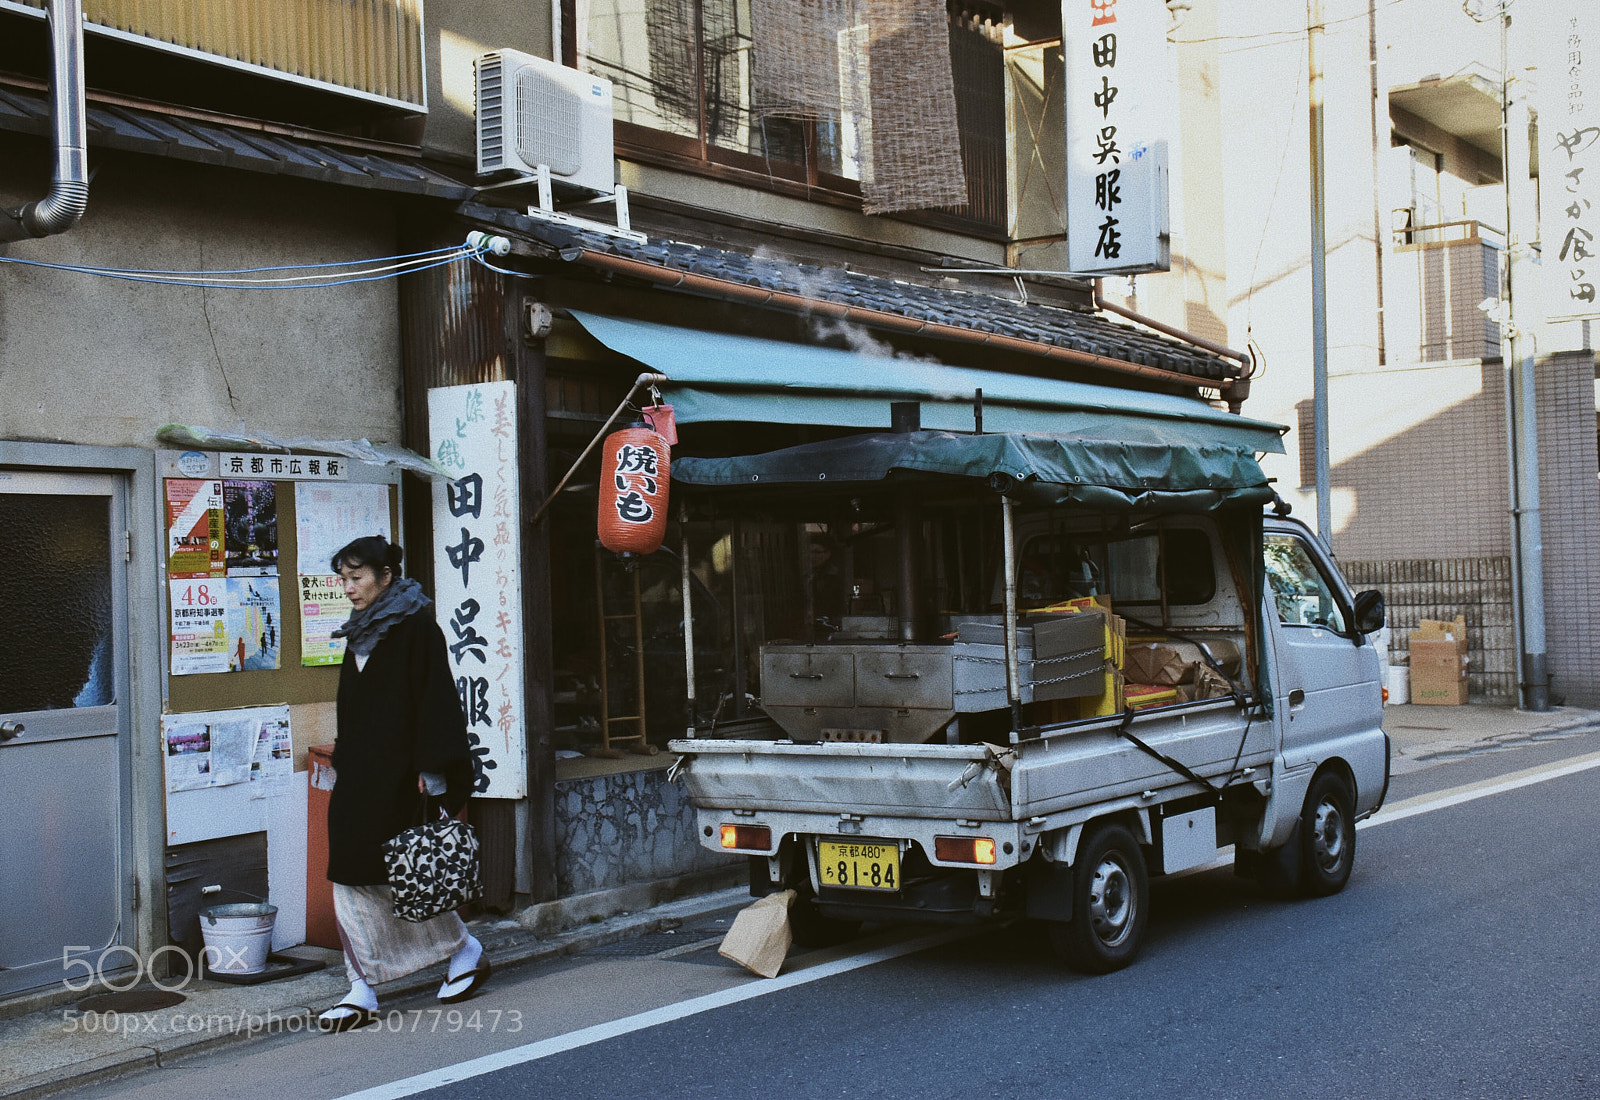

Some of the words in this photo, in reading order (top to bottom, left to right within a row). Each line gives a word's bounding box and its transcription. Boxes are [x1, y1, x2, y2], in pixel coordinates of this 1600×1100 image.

[1092, 33, 1122, 259] 田中呉服店
[615, 443, 658, 524] 焼いも
[174, 607, 225, 618] 京都府知事選挙
[826, 866, 834, 879] ち
[837, 861, 895, 887] 81-84
